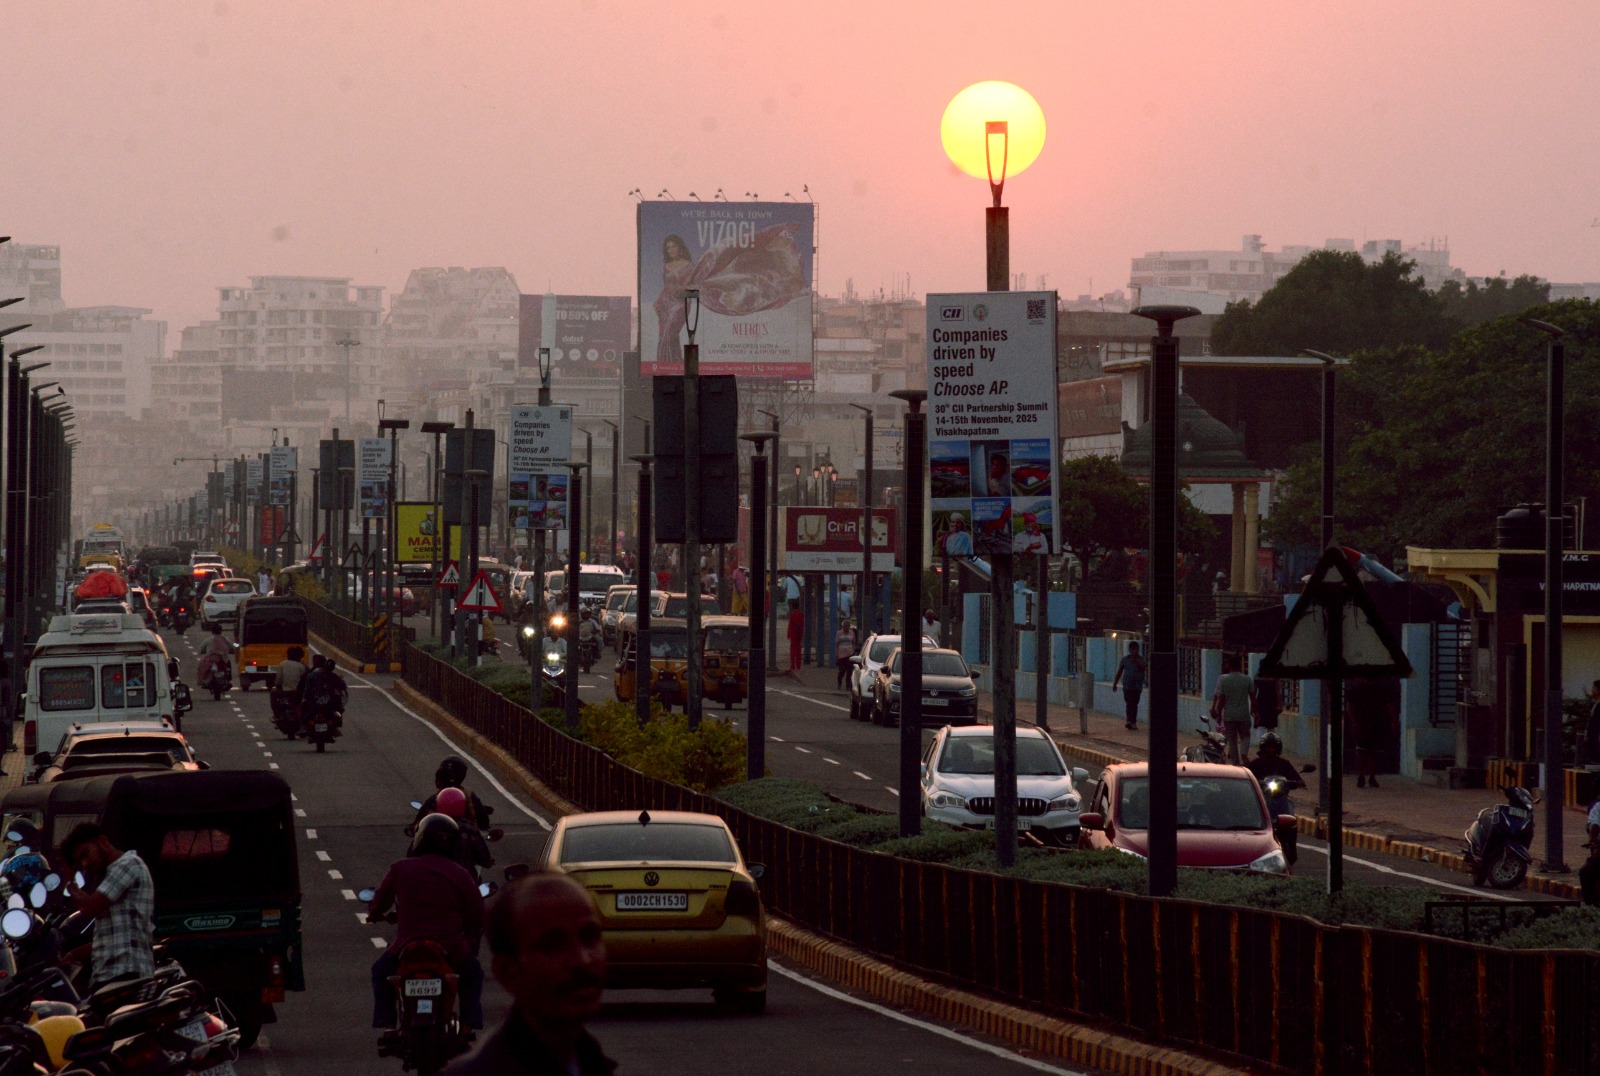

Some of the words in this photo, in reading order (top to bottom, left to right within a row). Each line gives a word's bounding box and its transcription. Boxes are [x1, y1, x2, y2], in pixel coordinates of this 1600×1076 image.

[710, 210, 731, 218] BACK
[748, 211, 773, 219] TOWN
[697, 220, 756, 248] VIZAG!
[590, 310, 609, 321] OFF
[942, 308, 962, 319] CII
[933, 327, 1008, 345] Companies
[933, 345, 975, 360] driven
[980, 345, 996, 362] by
[933, 362, 974, 380] speed
[934, 381, 985, 396] Choose
[988, 380, 1008, 396] AP.
[952, 404, 964, 412] CII
[966, 403, 1014, 413] Partnership
[1016, 402, 1048, 411] Summit
[514, 420, 550, 430] Companies
[935, 415, 968, 425] 14-15th
[971, 415, 1014, 424] November,
[1016, 414, 1038, 423] 2025
[536, 429, 544, 438] by
[935, 427, 1000, 437] Visakhapatnam
[513, 445, 539, 453] Choose
